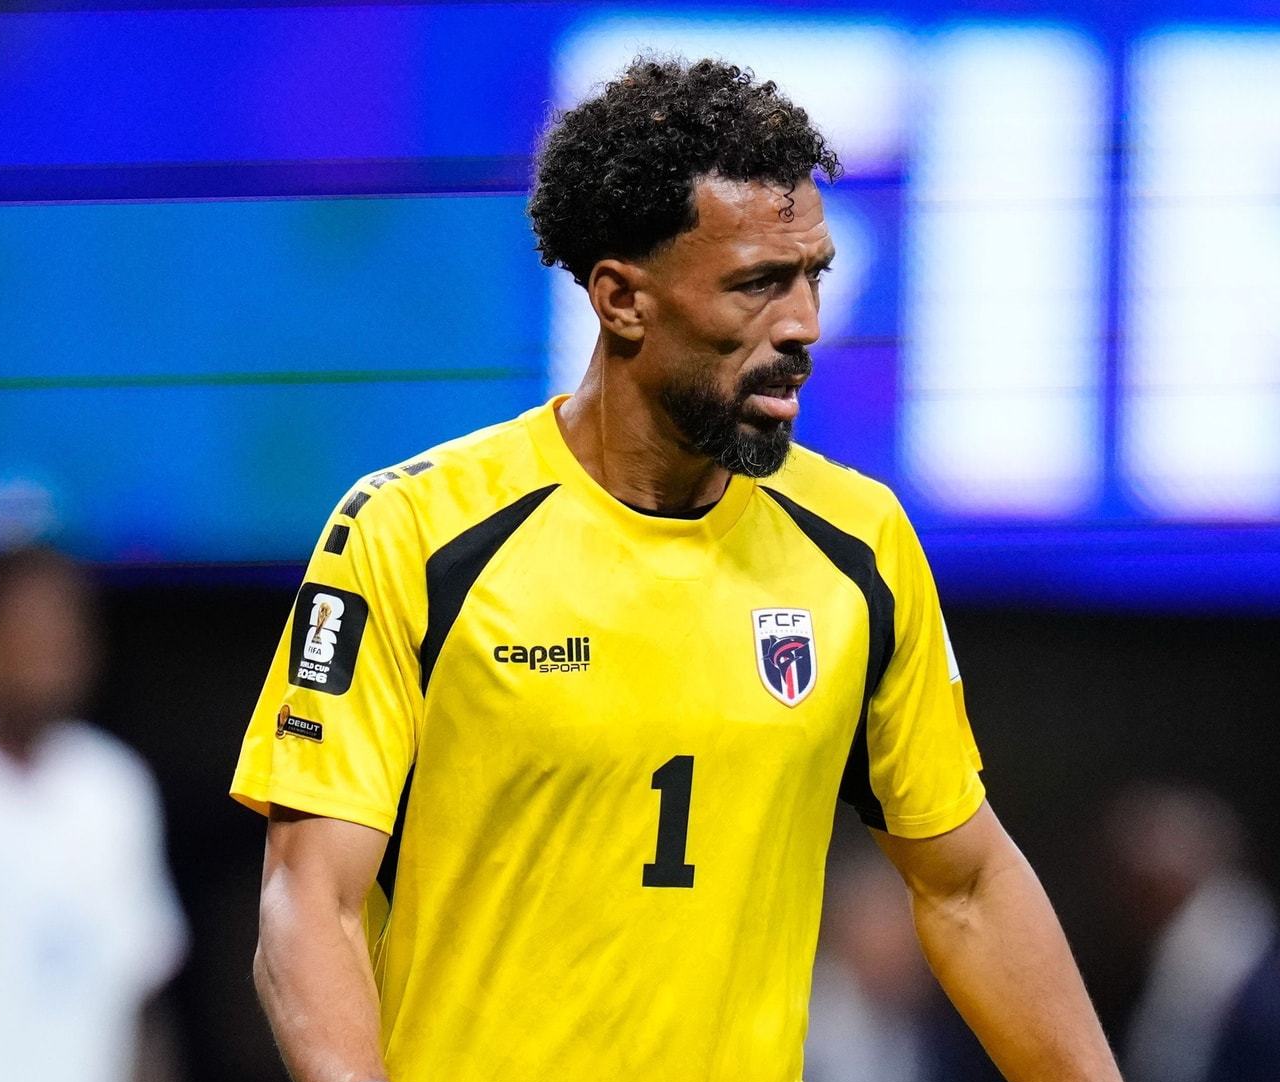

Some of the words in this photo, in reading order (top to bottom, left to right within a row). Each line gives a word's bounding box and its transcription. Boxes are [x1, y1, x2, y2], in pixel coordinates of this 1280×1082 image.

[758, 612, 806, 629] FCF
[493, 636, 590, 671] capelli
[297, 667, 328, 684] 2026
[314, 663, 331, 673] CUP
[539, 662, 590, 673] SPORT
[287, 717, 320, 732] DEBUT
[642, 755, 695, 888] 1
